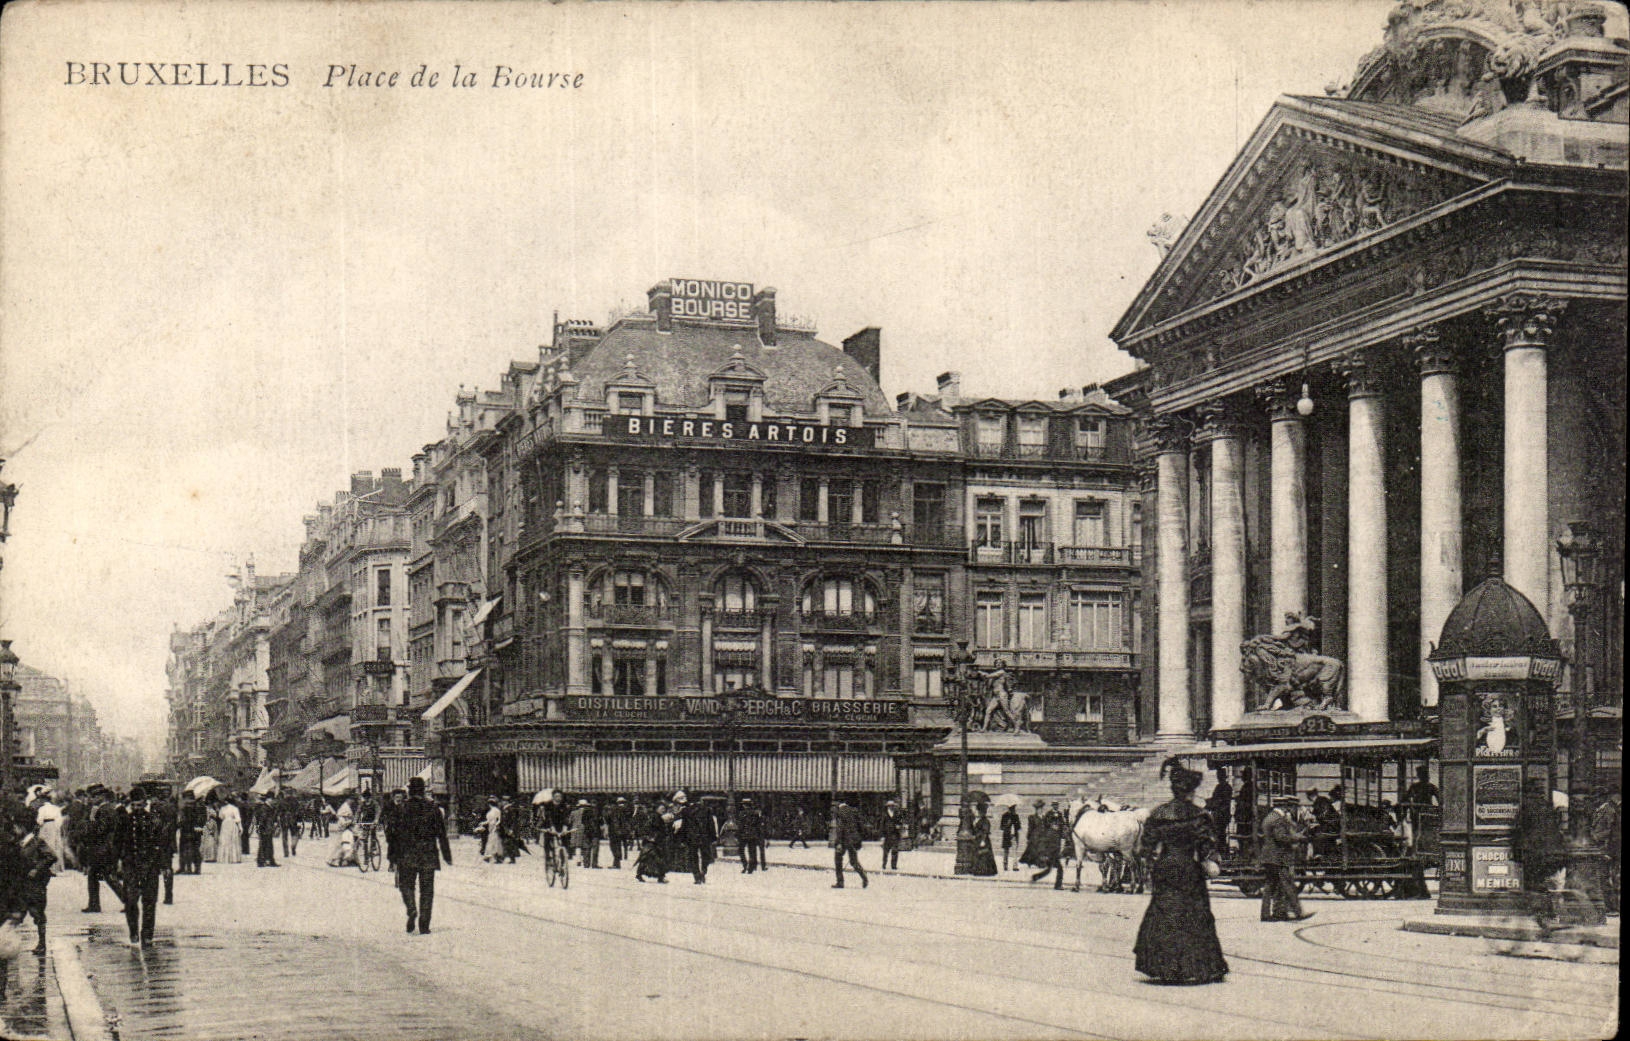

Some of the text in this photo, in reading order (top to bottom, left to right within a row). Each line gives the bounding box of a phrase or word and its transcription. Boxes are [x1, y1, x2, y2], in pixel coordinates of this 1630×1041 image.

[672, 280, 751, 300] MONICO
[672, 298, 751, 319] BOURSE
[749, 424, 847, 444] ARTOIS
[577, 697, 668, 711] DISTILLERIE
[812, 700, 897, 715] BRASSERIE
[1476, 877, 1520, 888] MENIER
